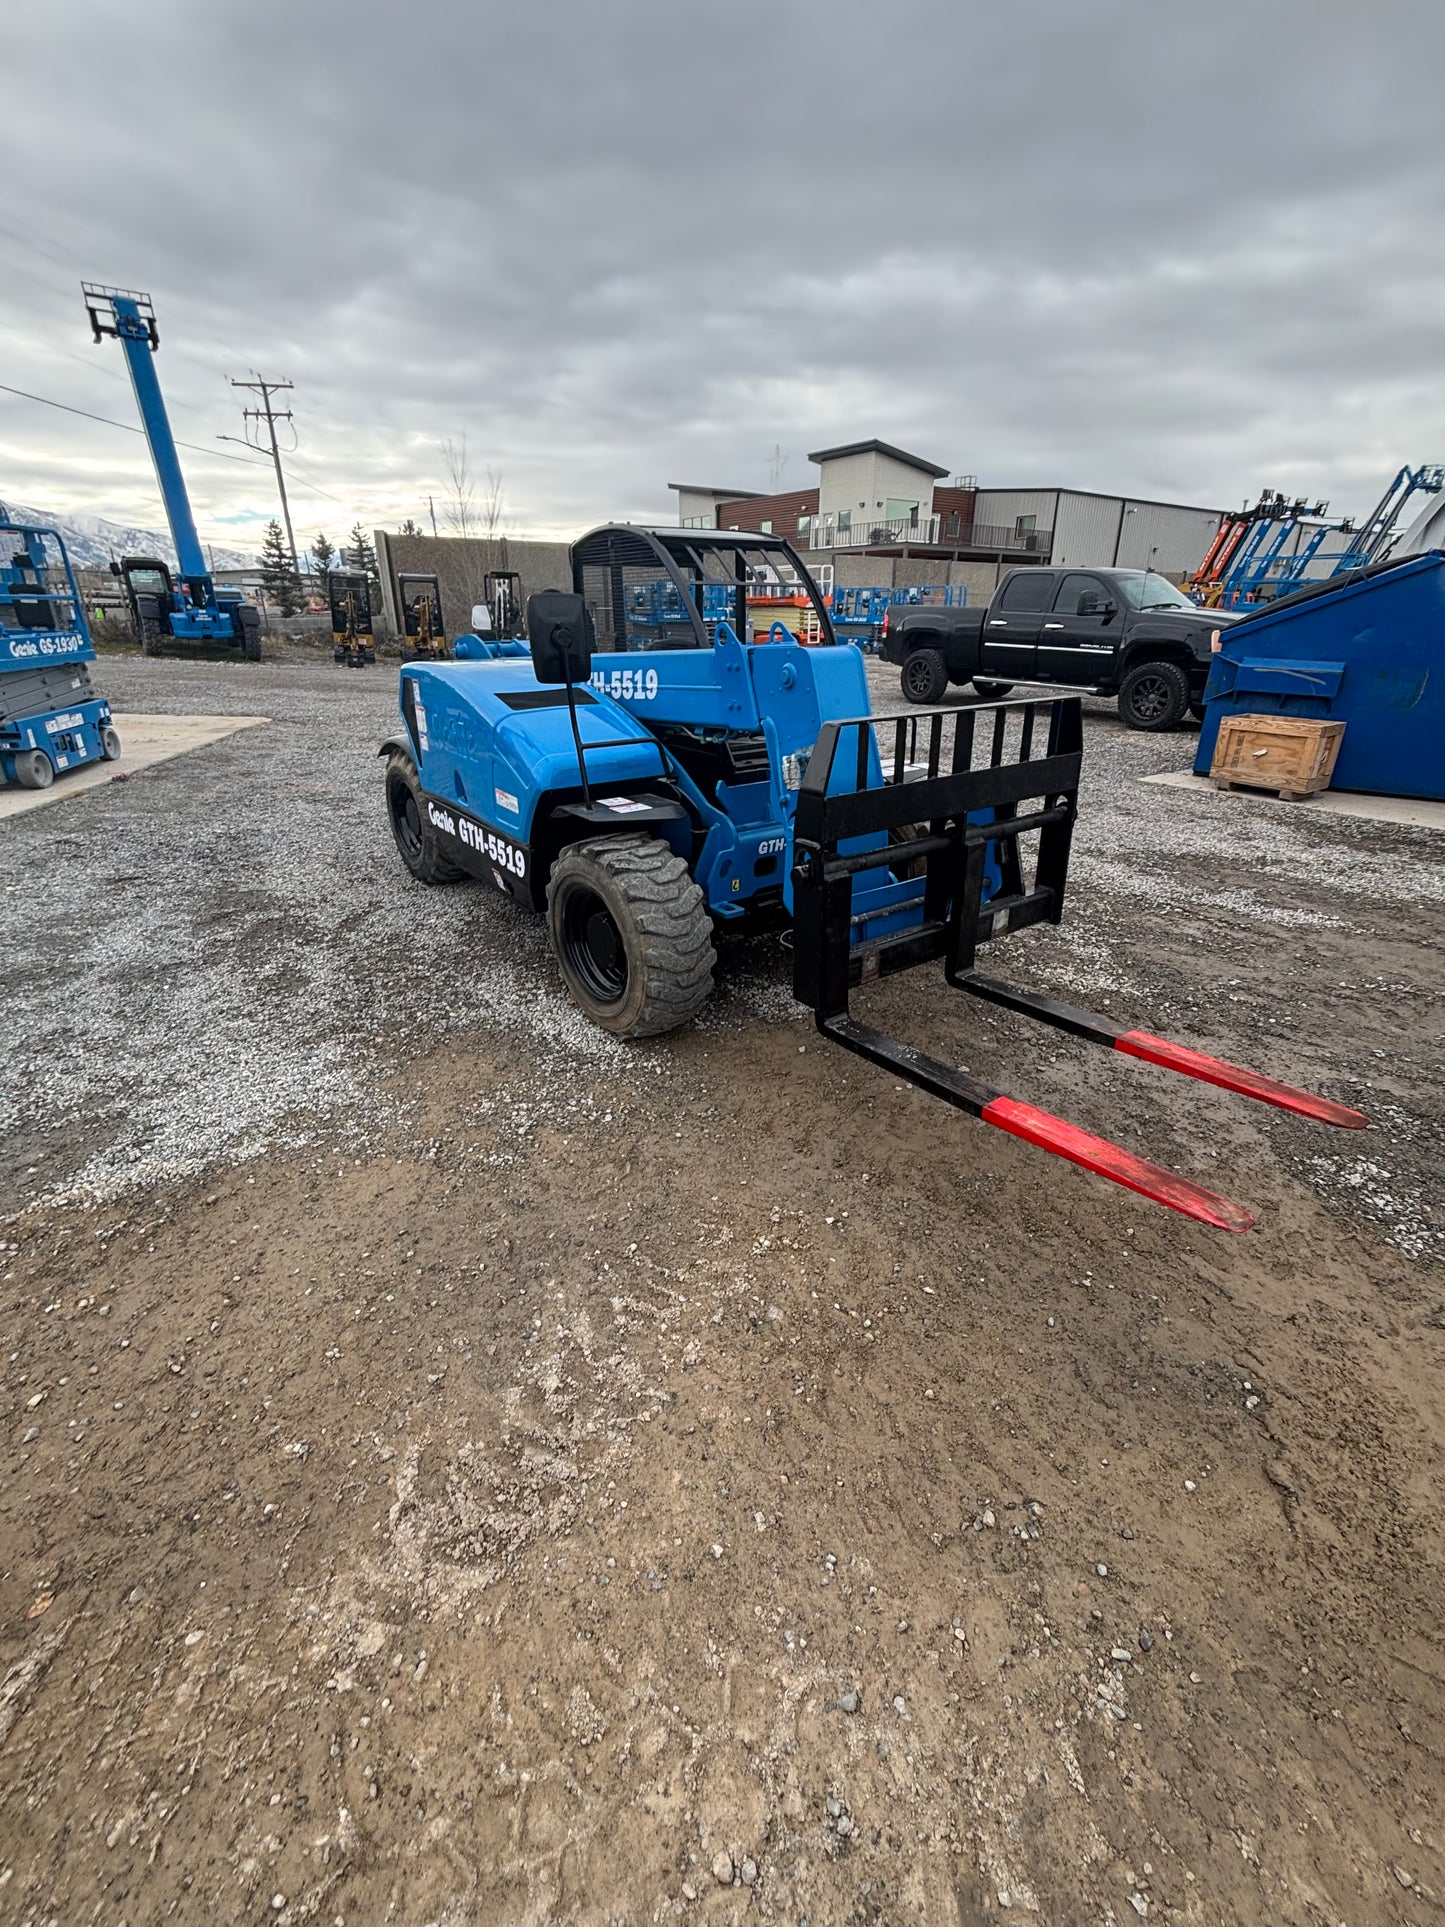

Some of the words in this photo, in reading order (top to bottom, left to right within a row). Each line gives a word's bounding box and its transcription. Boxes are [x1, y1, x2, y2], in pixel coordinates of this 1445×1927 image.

[9, 640, 39, 658] Genie
[427, 801, 456, 836] Genie
[458, 817, 526, 878] GTH-5519
[758, 837, 788, 855] GTH-
